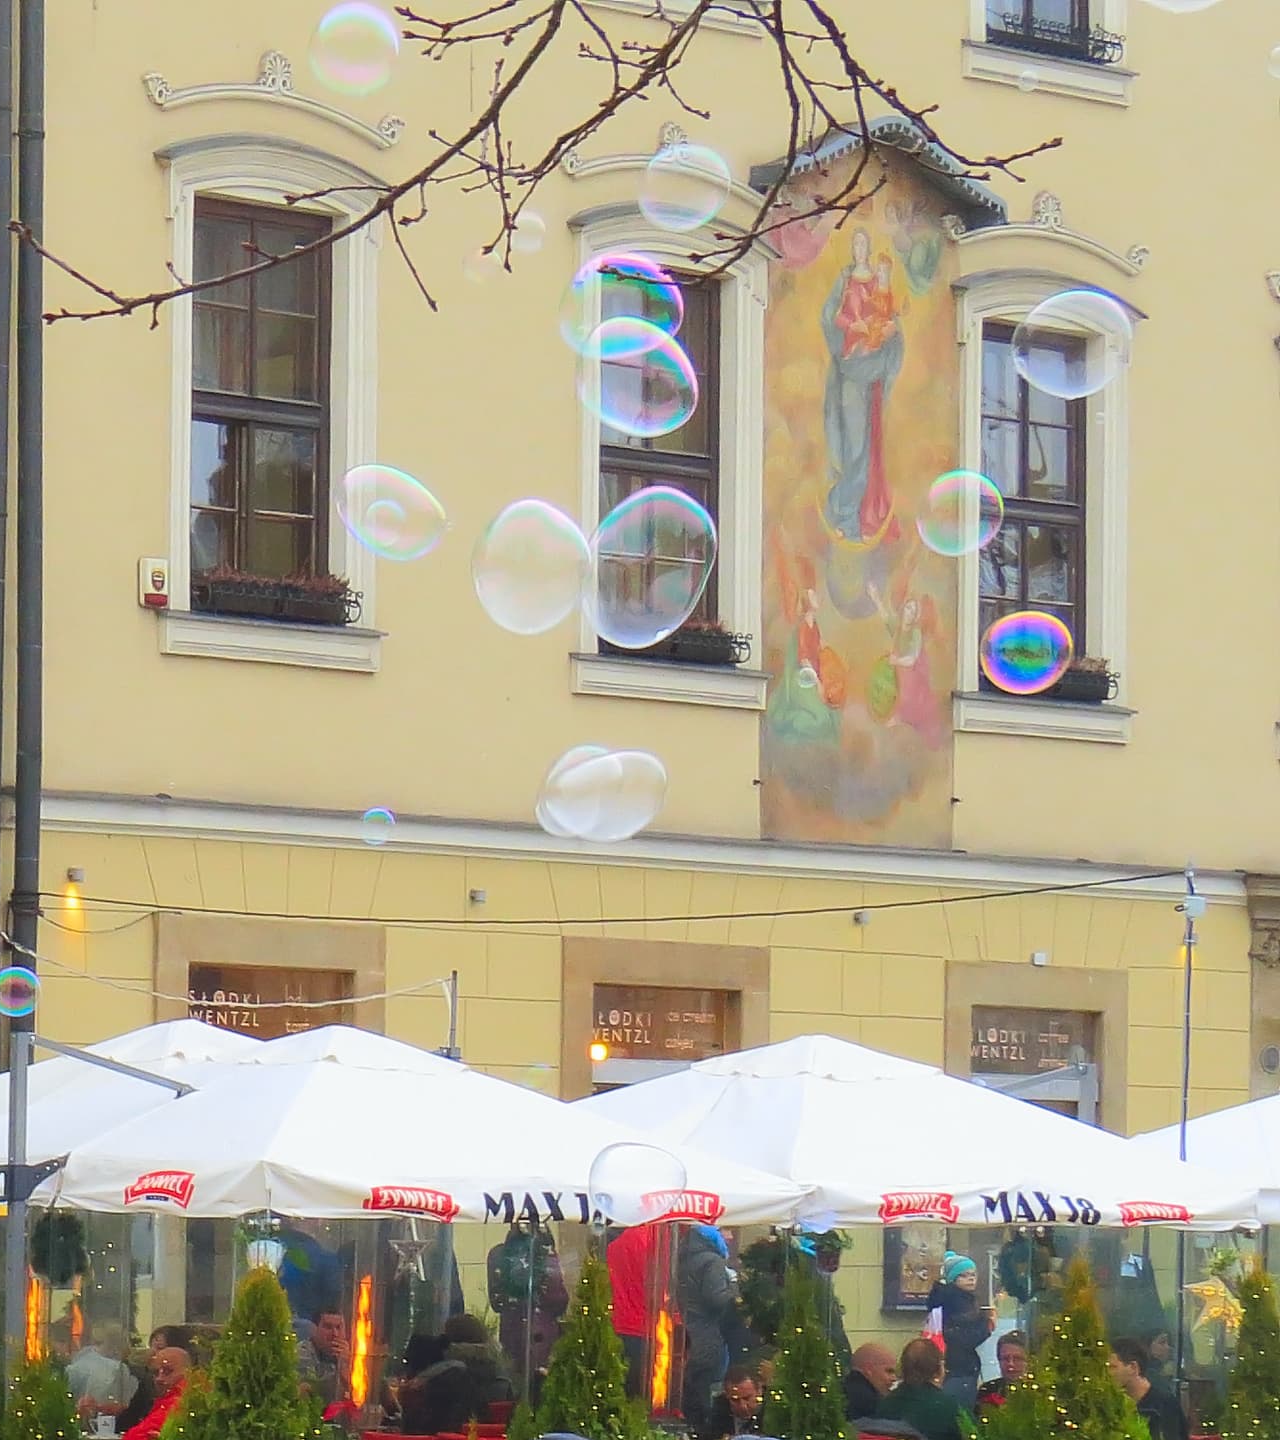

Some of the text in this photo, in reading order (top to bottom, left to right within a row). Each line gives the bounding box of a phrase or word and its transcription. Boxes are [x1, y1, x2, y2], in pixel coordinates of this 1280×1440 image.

[483, 1191, 564, 1224] MAX
[979, 1190, 1102, 1226] MAX 18
